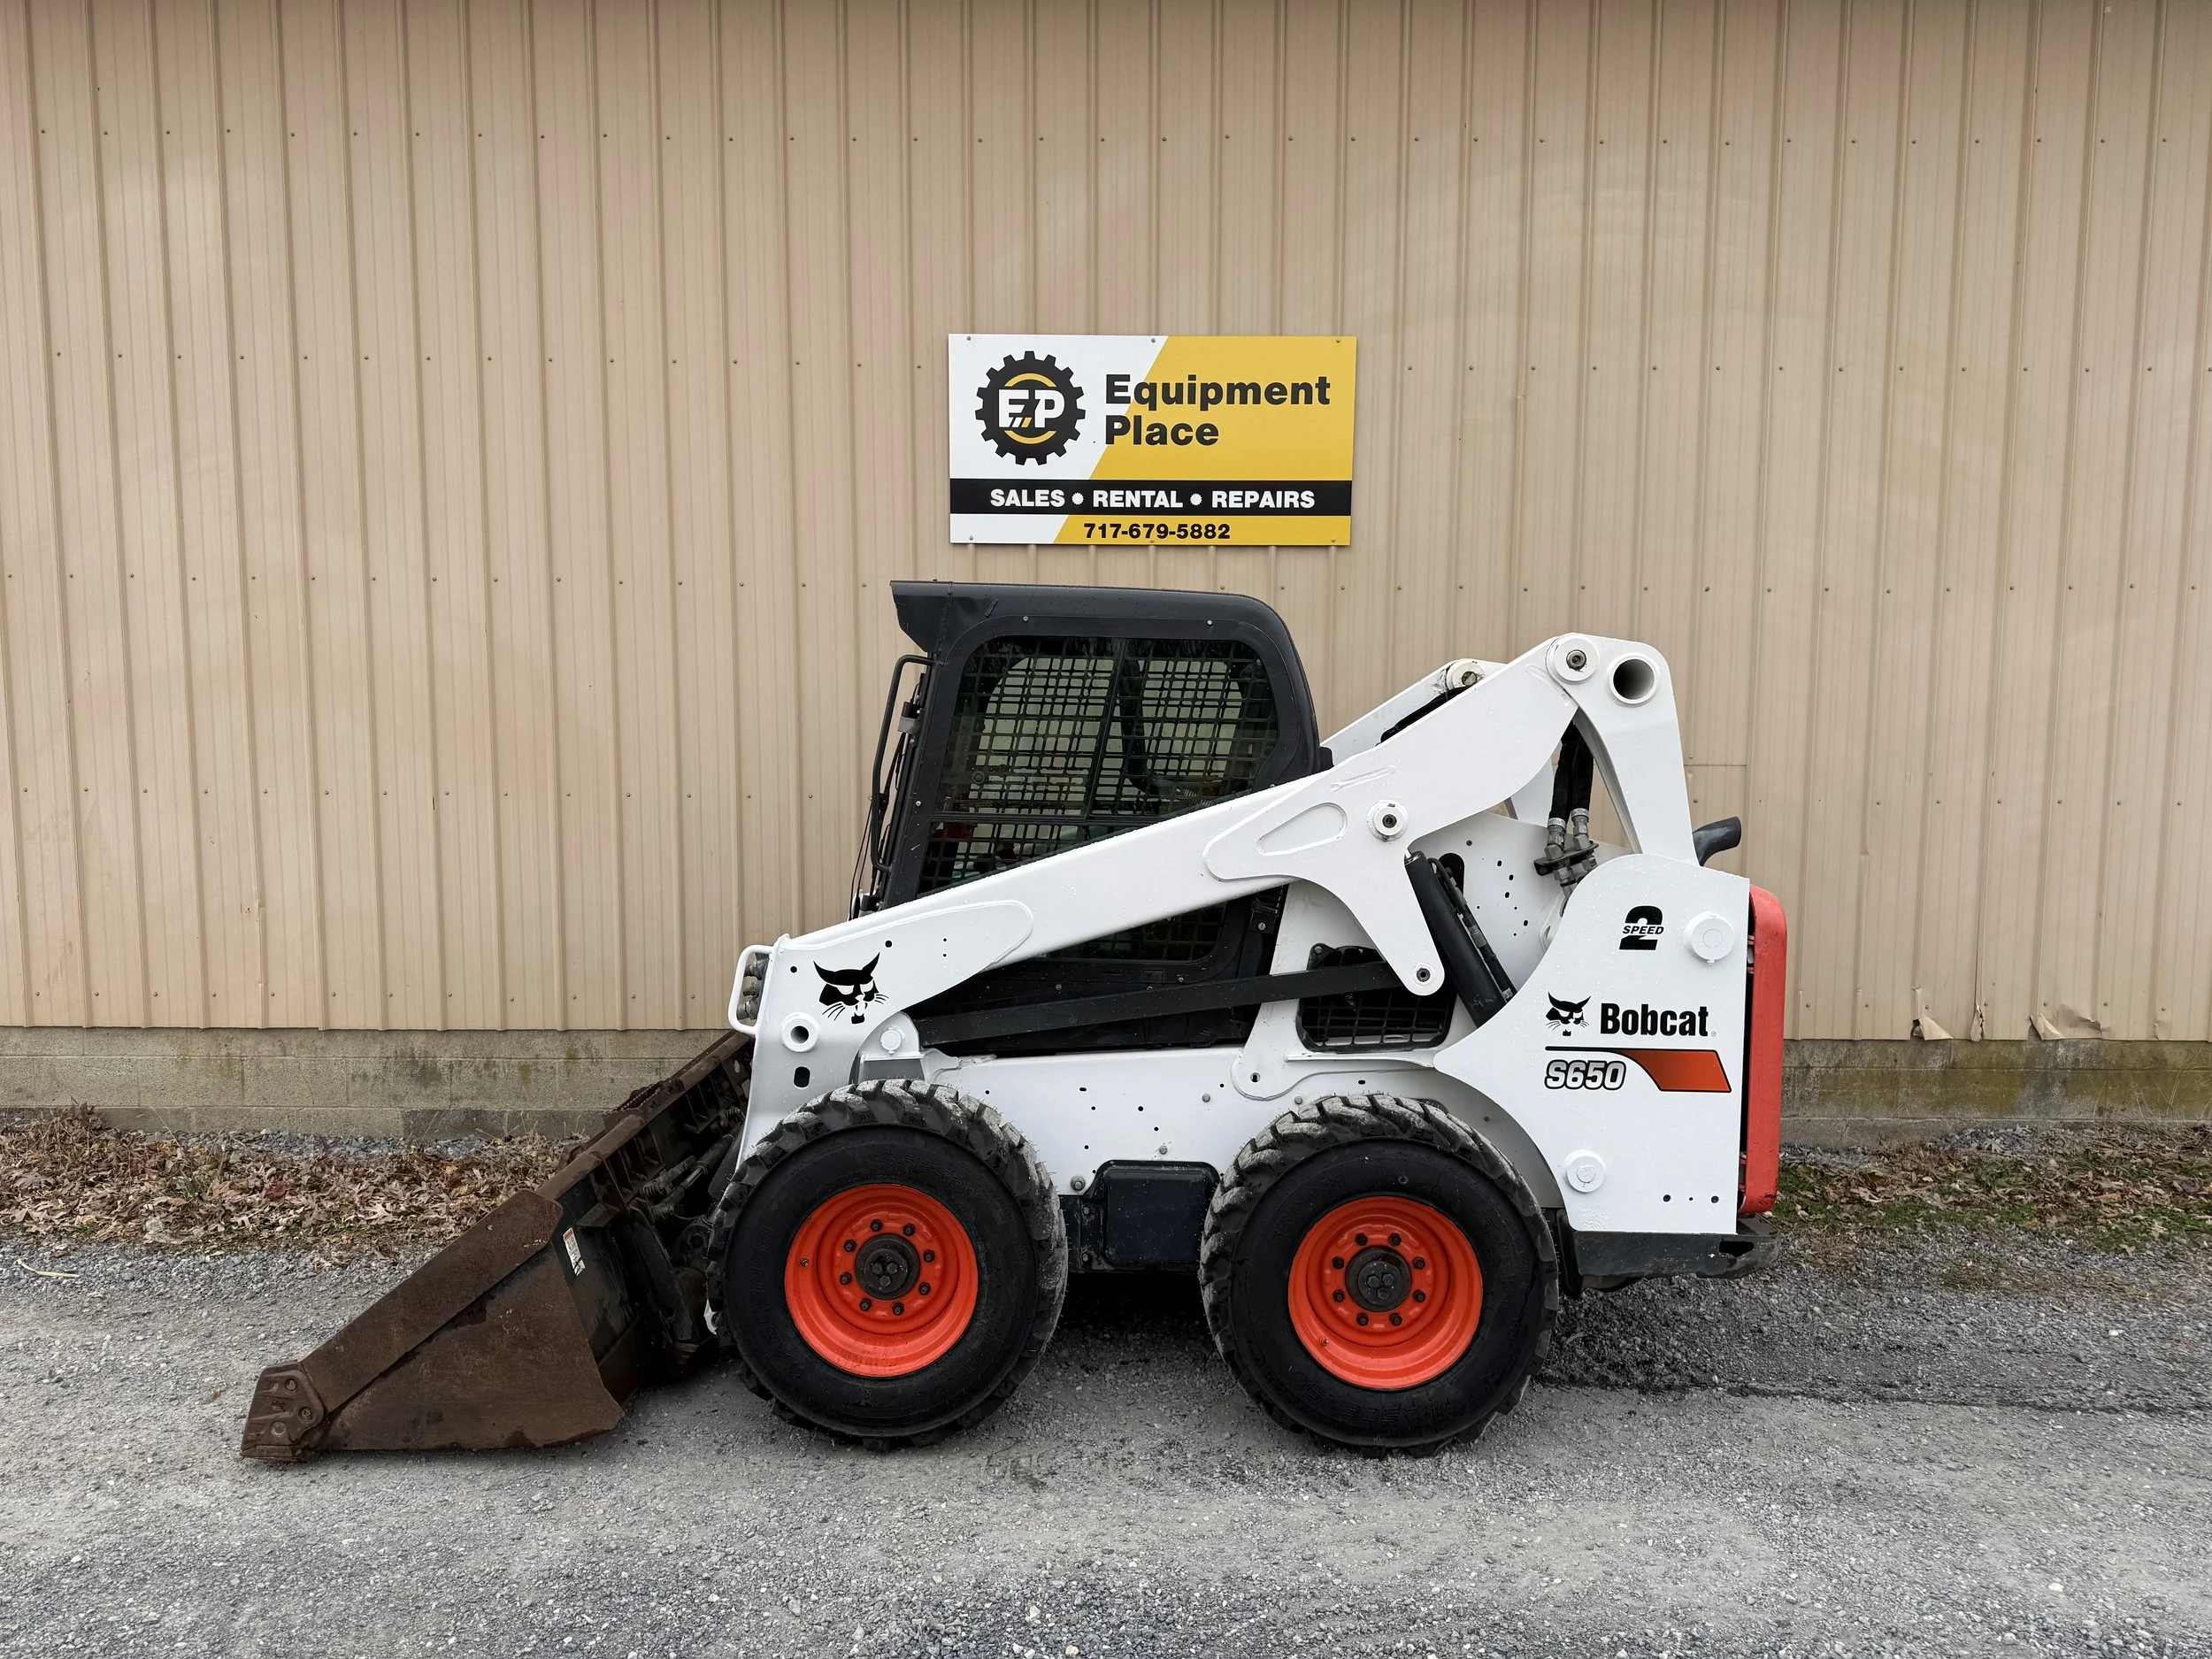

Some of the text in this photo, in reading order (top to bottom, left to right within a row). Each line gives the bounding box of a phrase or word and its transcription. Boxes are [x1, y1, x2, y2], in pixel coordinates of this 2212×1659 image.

[1105, 373, 1331, 411] Equipment
[1104, 414, 1219, 445] Place
[990, 489, 1316, 510] SALES RENTAL REPAIRS
[1084, 524, 1230, 539] 717-679-5882
[1622, 925, 1664, 935] SPEED
[1600, 1002, 1709, 1037] Bobcat
[1544, 1059, 1626, 1090] S650
